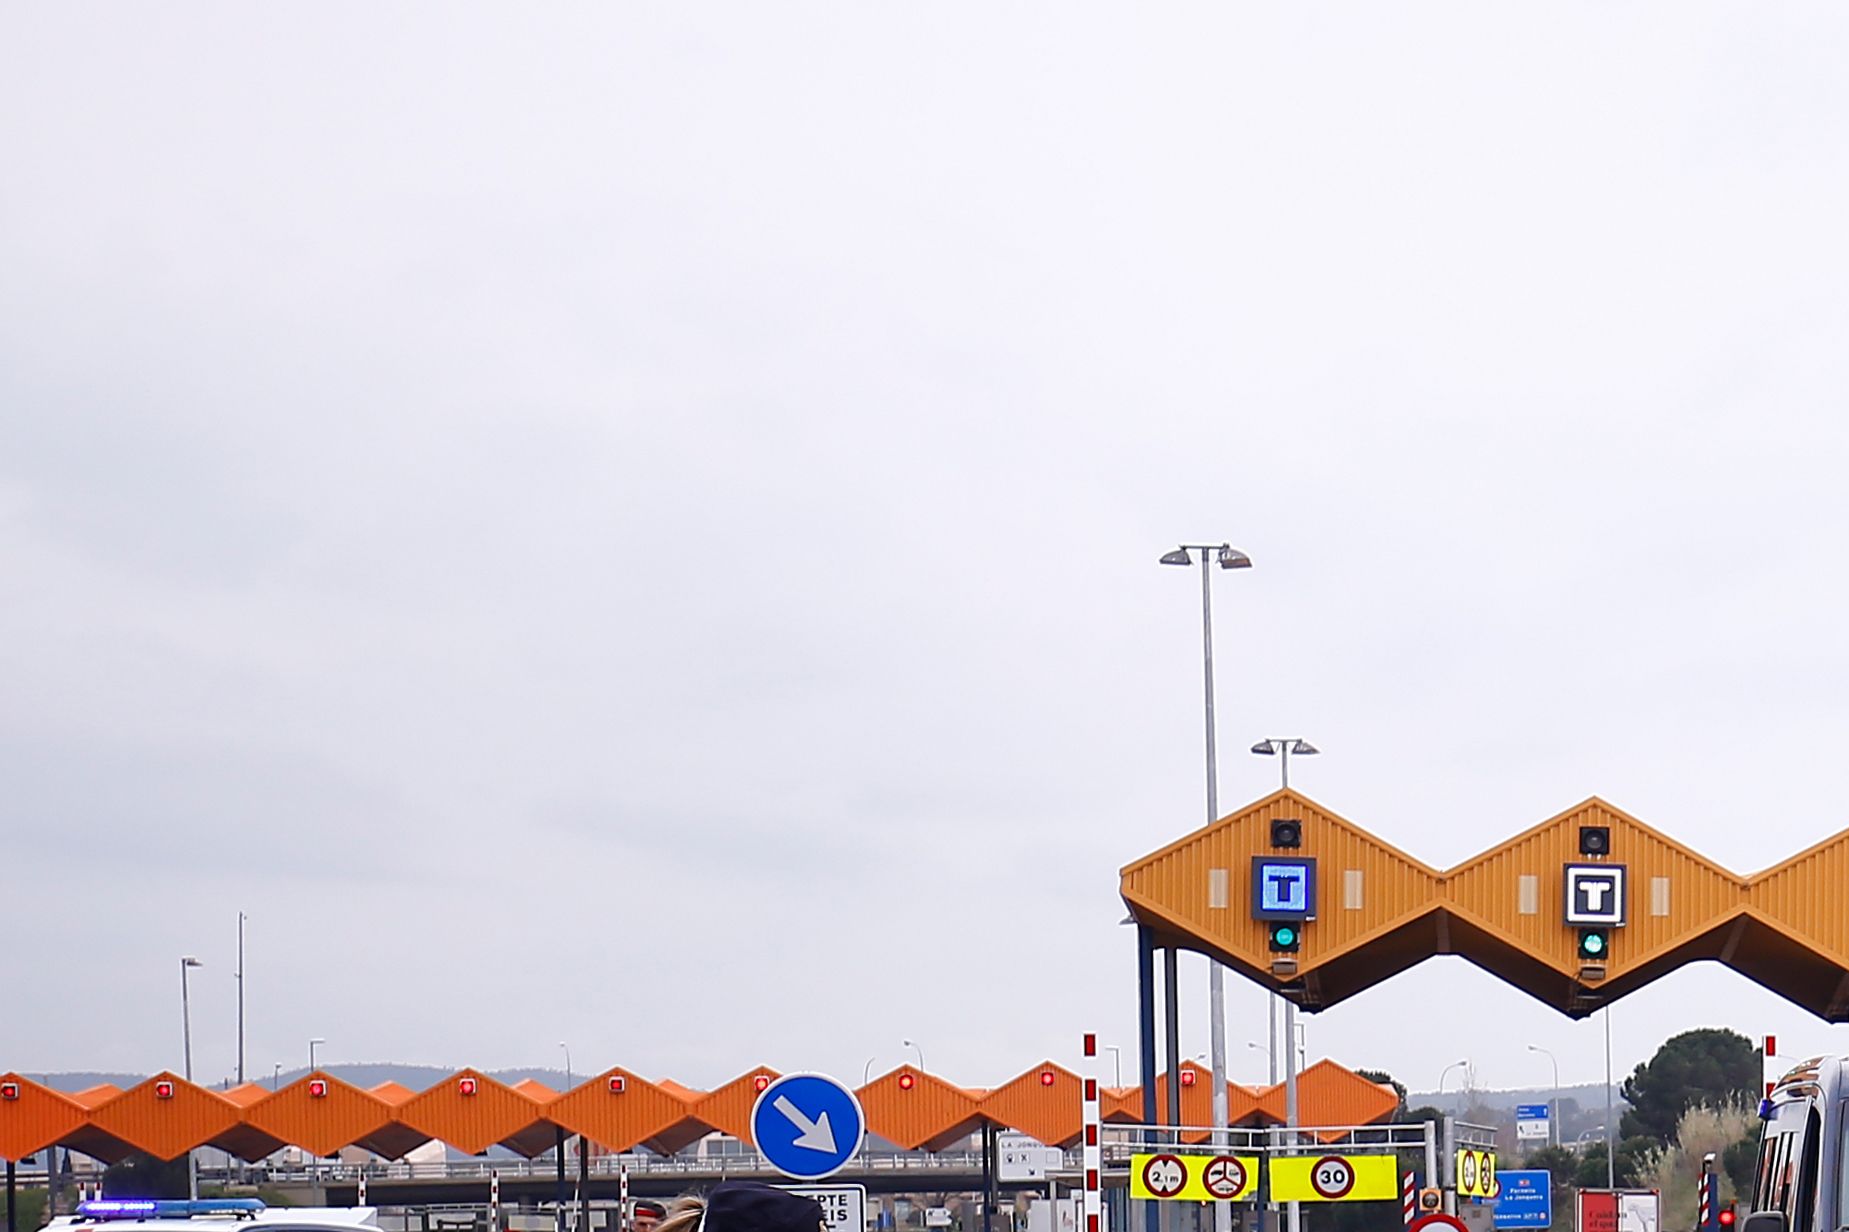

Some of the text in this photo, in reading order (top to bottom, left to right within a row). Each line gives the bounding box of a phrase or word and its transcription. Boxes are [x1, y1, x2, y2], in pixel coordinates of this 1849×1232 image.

[1268, 875, 1300, 902] T
[1579, 881, 1611, 911] T
[1321, 1170, 1345, 1184] 30
[806, 1195, 848, 1206] PTE
